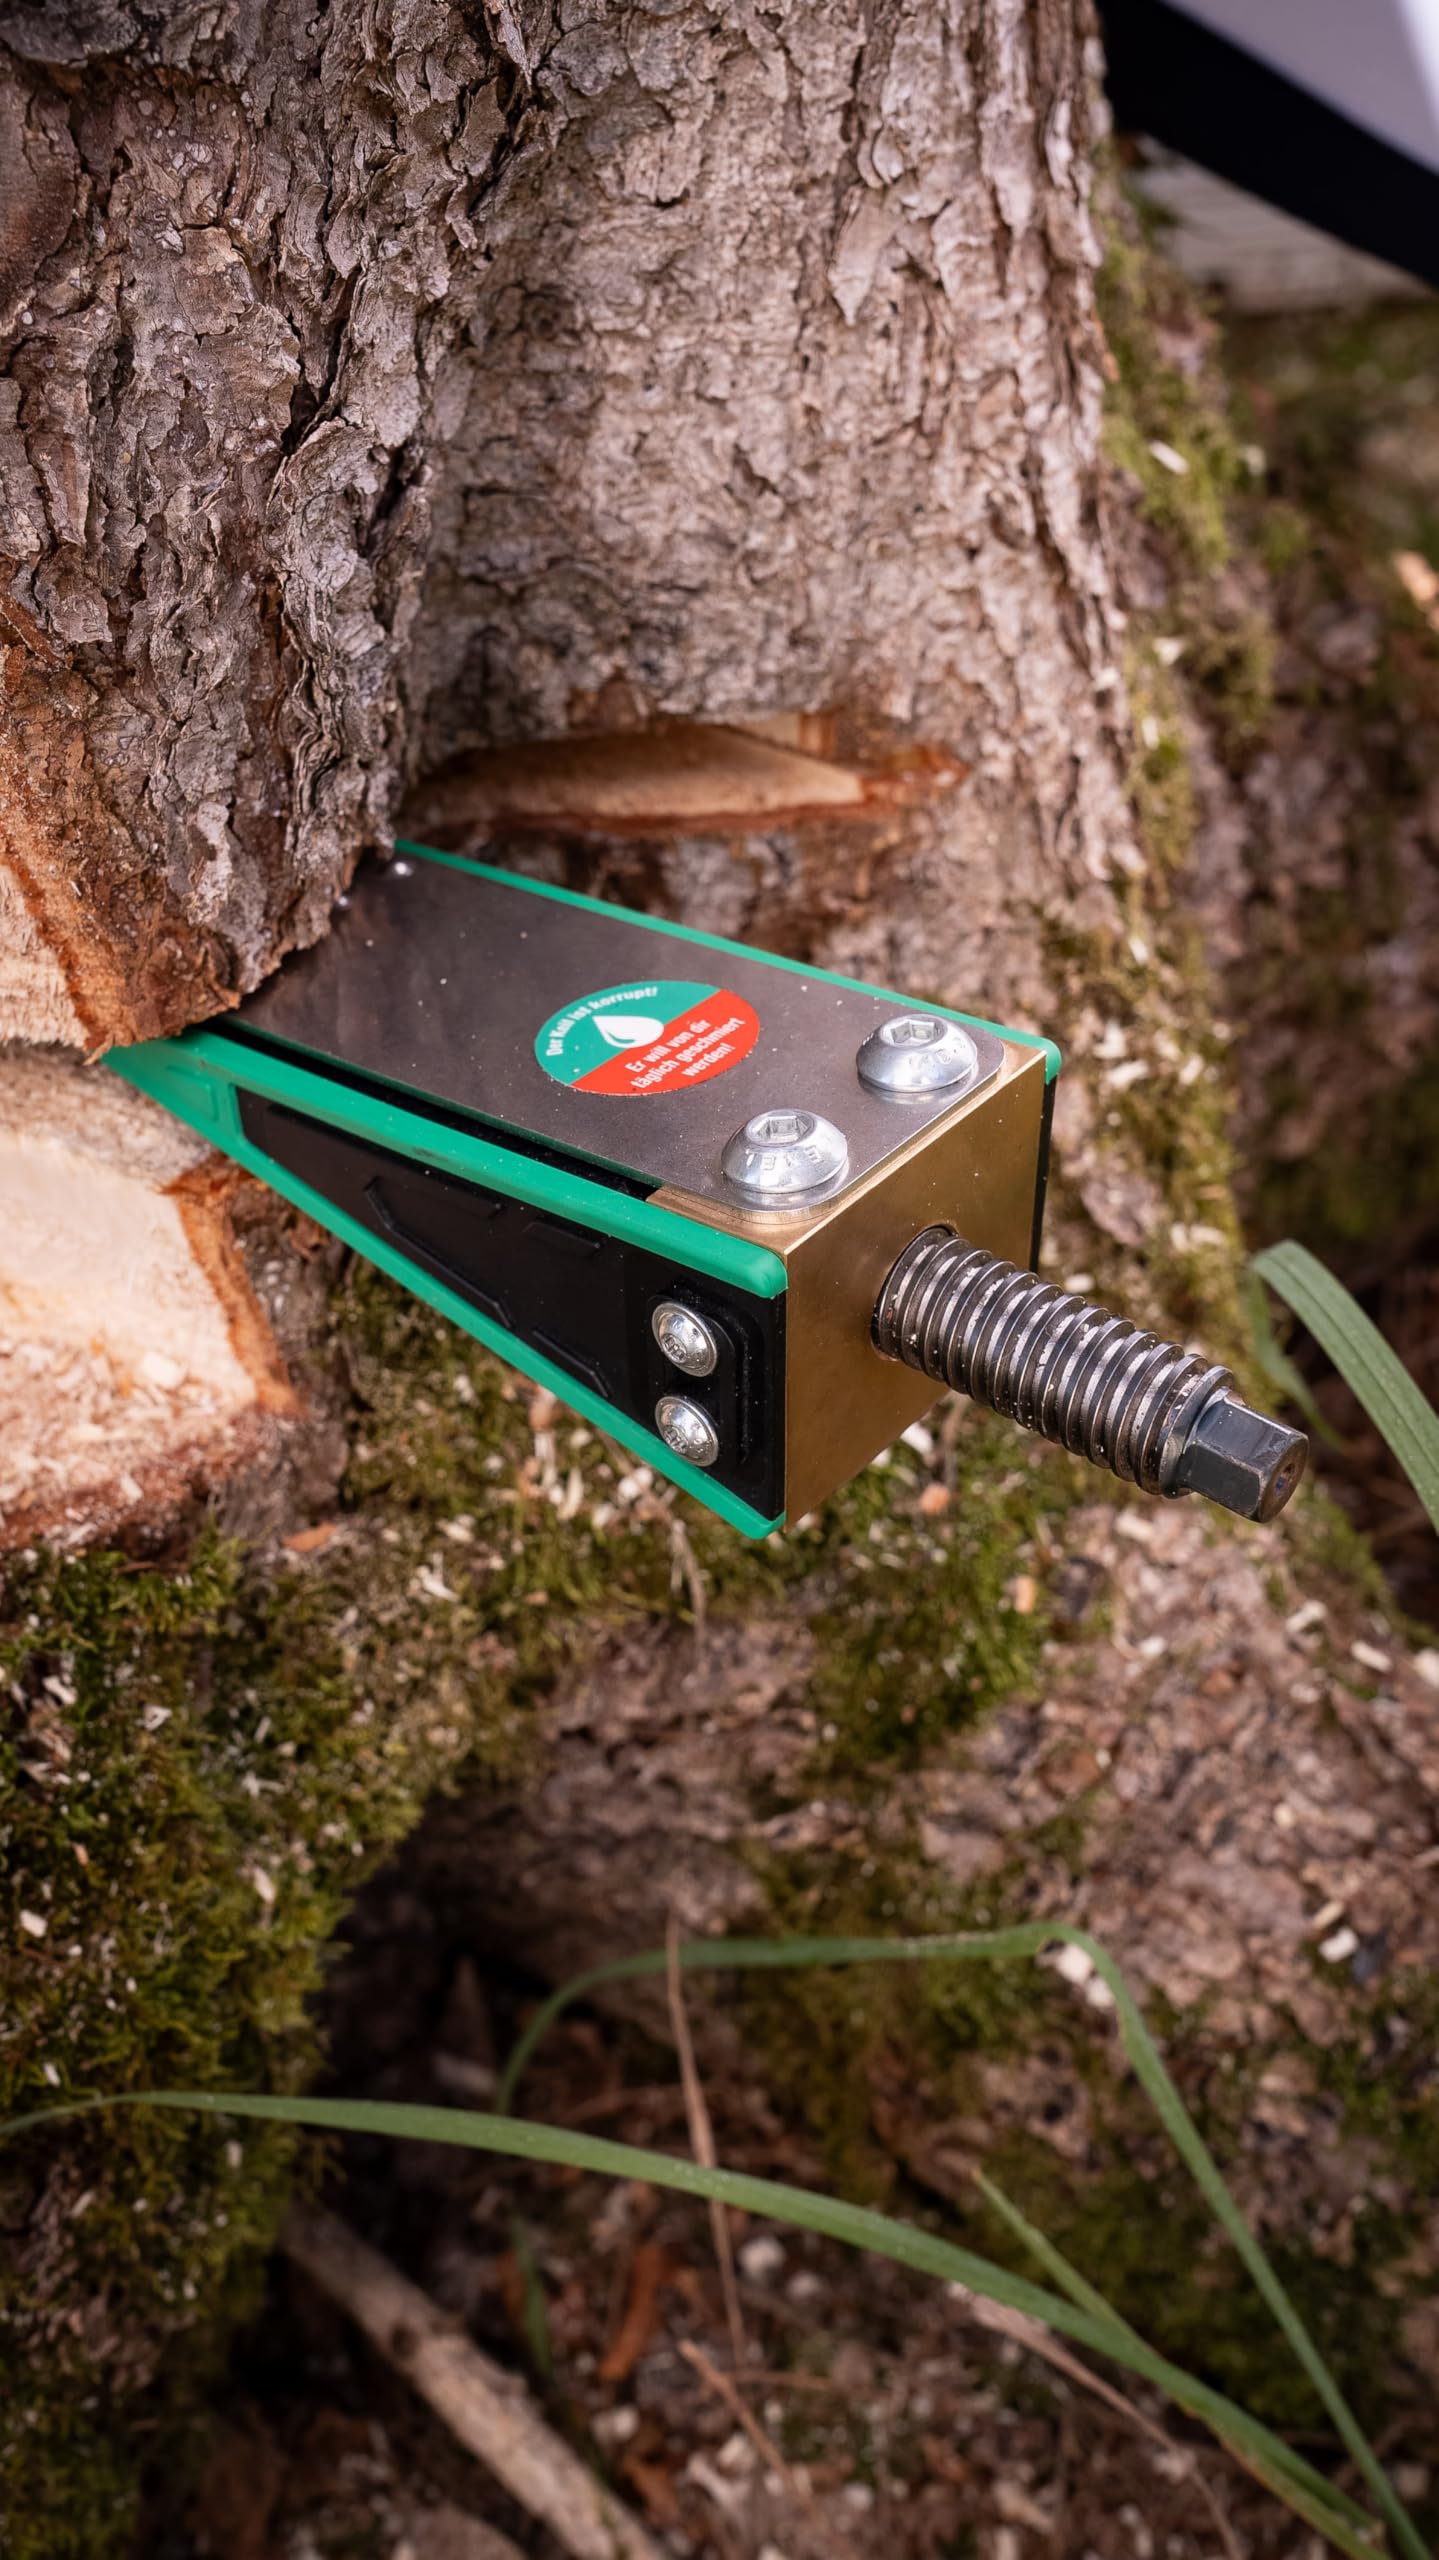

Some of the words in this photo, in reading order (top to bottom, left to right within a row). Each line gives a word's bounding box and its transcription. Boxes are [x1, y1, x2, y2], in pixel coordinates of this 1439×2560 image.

[587, 987, 658, 1009] korrupt!
[566, 1006, 592, 1021] ist
[549, 1018, 576, 1038] Keil
[546, 1039, 564, 1056] Der
[625, 1060, 647, 1073] Er
[643, 1045, 671, 1063] will
[666, 1031, 694, 1048] von
[687, 1020, 711, 1034] dir
[630, 1060, 680, 1088] täglich
[675, 1017, 745, 1063] geschmiert
[681, 1042, 735, 1076] werden!
